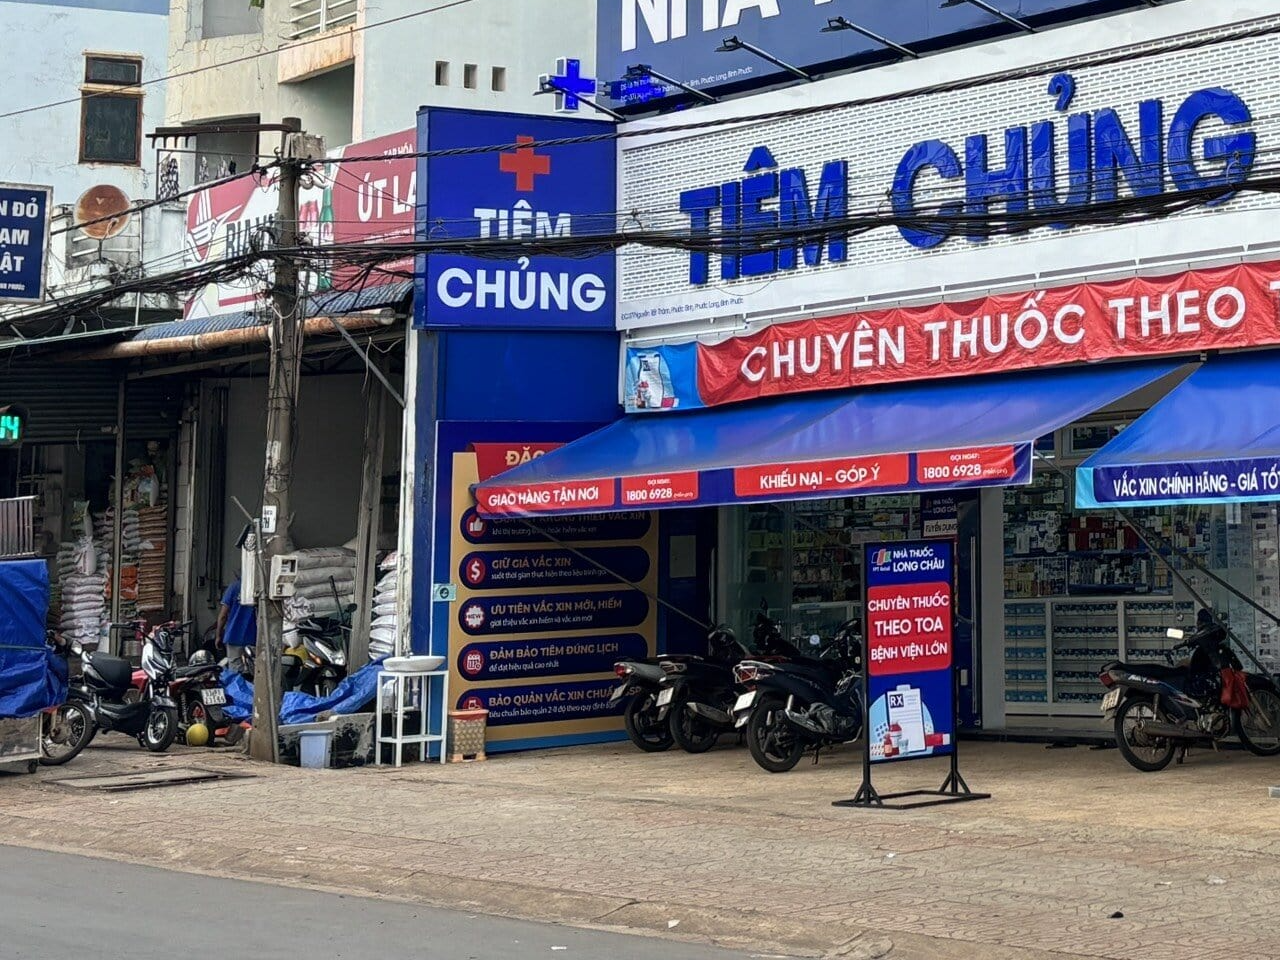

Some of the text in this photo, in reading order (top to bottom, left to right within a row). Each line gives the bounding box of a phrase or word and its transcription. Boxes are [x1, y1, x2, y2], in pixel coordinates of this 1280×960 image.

[680, 146, 850, 286] TIÊM
[896, 72, 1257, 249] CHỦNG
[12, 197, 39, 218] ĐỎ
[358, 172, 388, 222] ÚT
[474, 199, 571, 244] TIÊM
[437, 256, 607, 312] CHỦNG
[740, 320, 906, 384] CHUYÊN
[924, 290, 1087, 363] THUỐC
[1109, 285, 1247, 339] THEO
[760, 463, 880, 491] KHIẾU NẠI GÓP Ý
[924, 466, 950, 479] 1800
[952, 463, 982, 477] 6928
[1113, 470, 1137, 497] VẮC
[1139, 477, 1158, 496] XIN
[1159, 471, 1193, 495] CHÍNH
[1237, 467, 1259, 491] GIÁ
[488, 486, 599, 507] GIAO HÀNG TẬN NƠI
[626, 489, 647, 501] 1800
[649, 488, 673, 499] 6928
[492, 553, 572, 569] GIỮ GIÁ VẮC XIN
[893, 546, 934, 559] NHÀ THUỐC
[893, 557, 945, 572] LONG CHÂU
[491, 596, 622, 615] ƯU TIÊN VẮC XIN MỚI, HIẾM
[868, 591, 950, 612] CHUYÊN THUỐC
[874, 617, 944, 637] THEO TOA
[489, 642, 619, 660] ĐẢM BẢO TIÊM ĐÚNG LỊCH
[870, 640, 948, 664] BỆNH VIỆN LỚN
[488, 688, 584, 707] BẢO QUẢN VẮC XIN
[890, 695, 904, 708] RX
